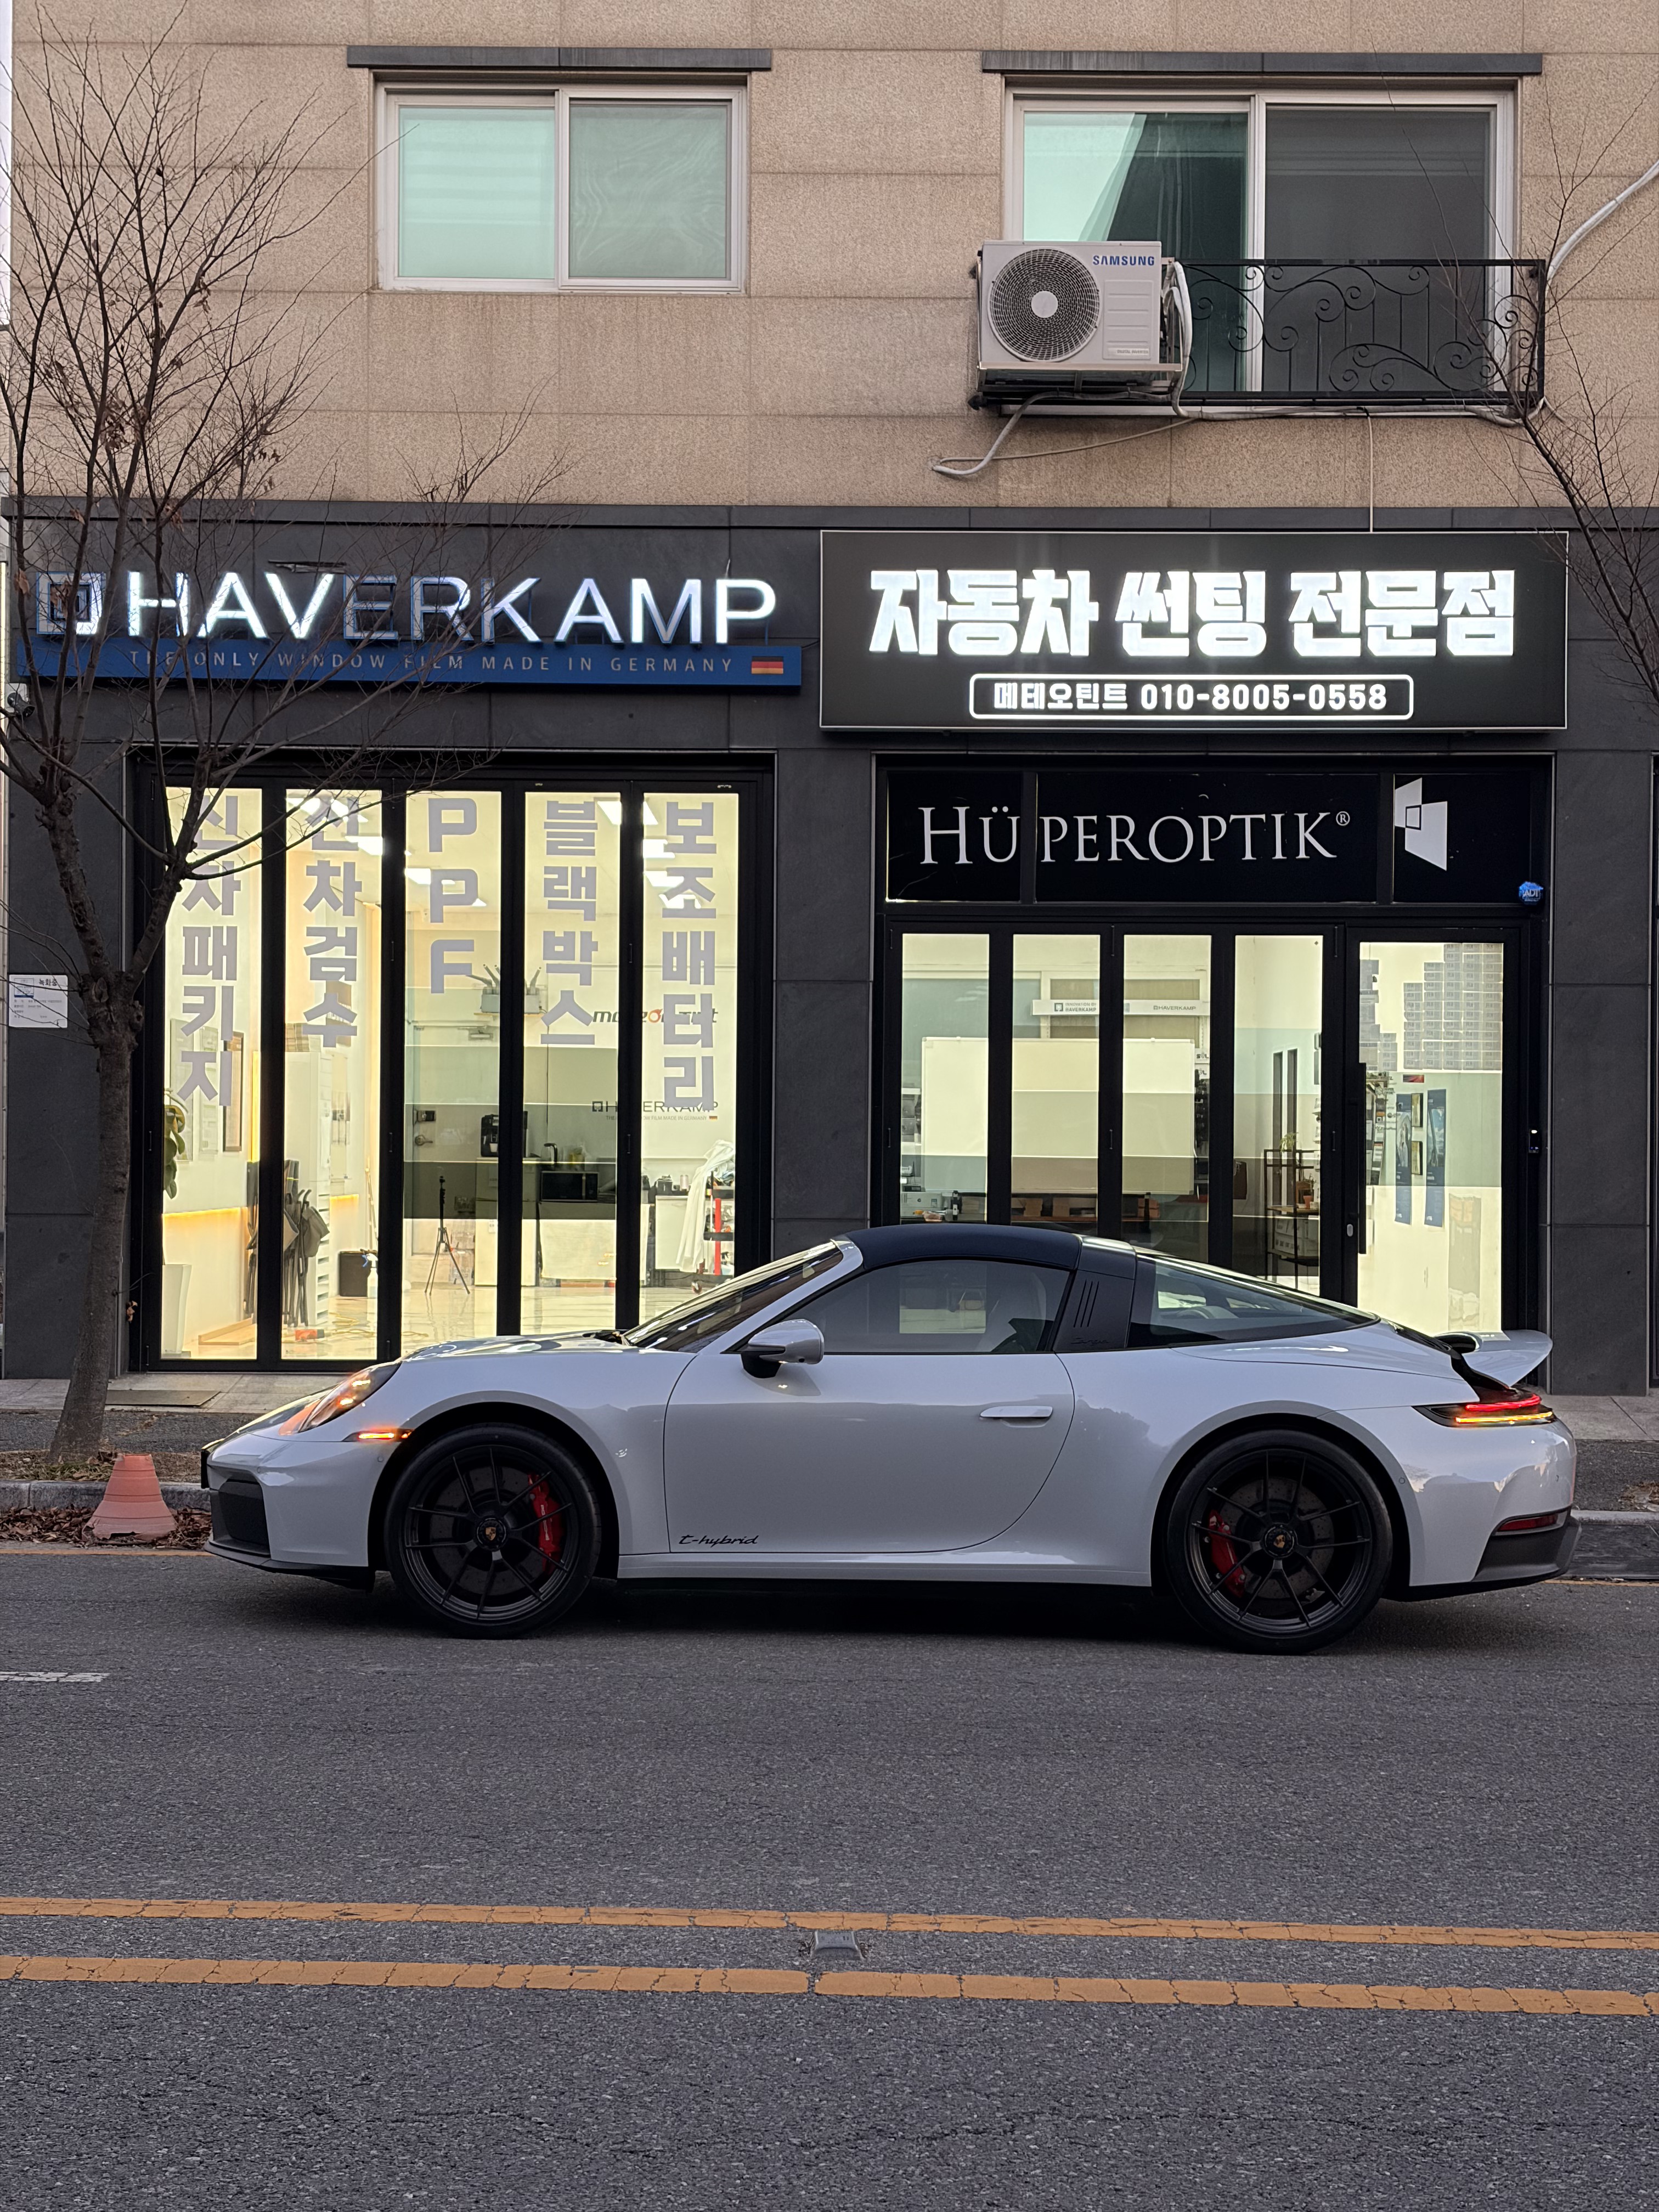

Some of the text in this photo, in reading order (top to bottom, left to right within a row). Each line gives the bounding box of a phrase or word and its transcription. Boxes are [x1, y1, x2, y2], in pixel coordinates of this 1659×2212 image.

[1093, 255, 1154, 266] SAMSUNG
[127, 571, 776, 644] HAVERKAMP
[869, 569, 1515, 657] 자동차 썬팅 전문점
[195, 652, 259, 666] ONLY
[482, 657, 549, 670] MADE
[569, 657, 591, 670] IN
[611, 658, 732, 672] GERMANY
[994, 682, 1387, 710] 메테오틴트 010-8005-0558
[427, 798, 478, 994] PPF
[540, 800, 598, 1045] 블랙박스
[1523, 889, 1538, 898] ADT
[177, 795, 241, 1106] 신차패키지
[662, 802, 717, 1110] 보조배터리
[679, 1534, 759, 1548] t-hybrid
